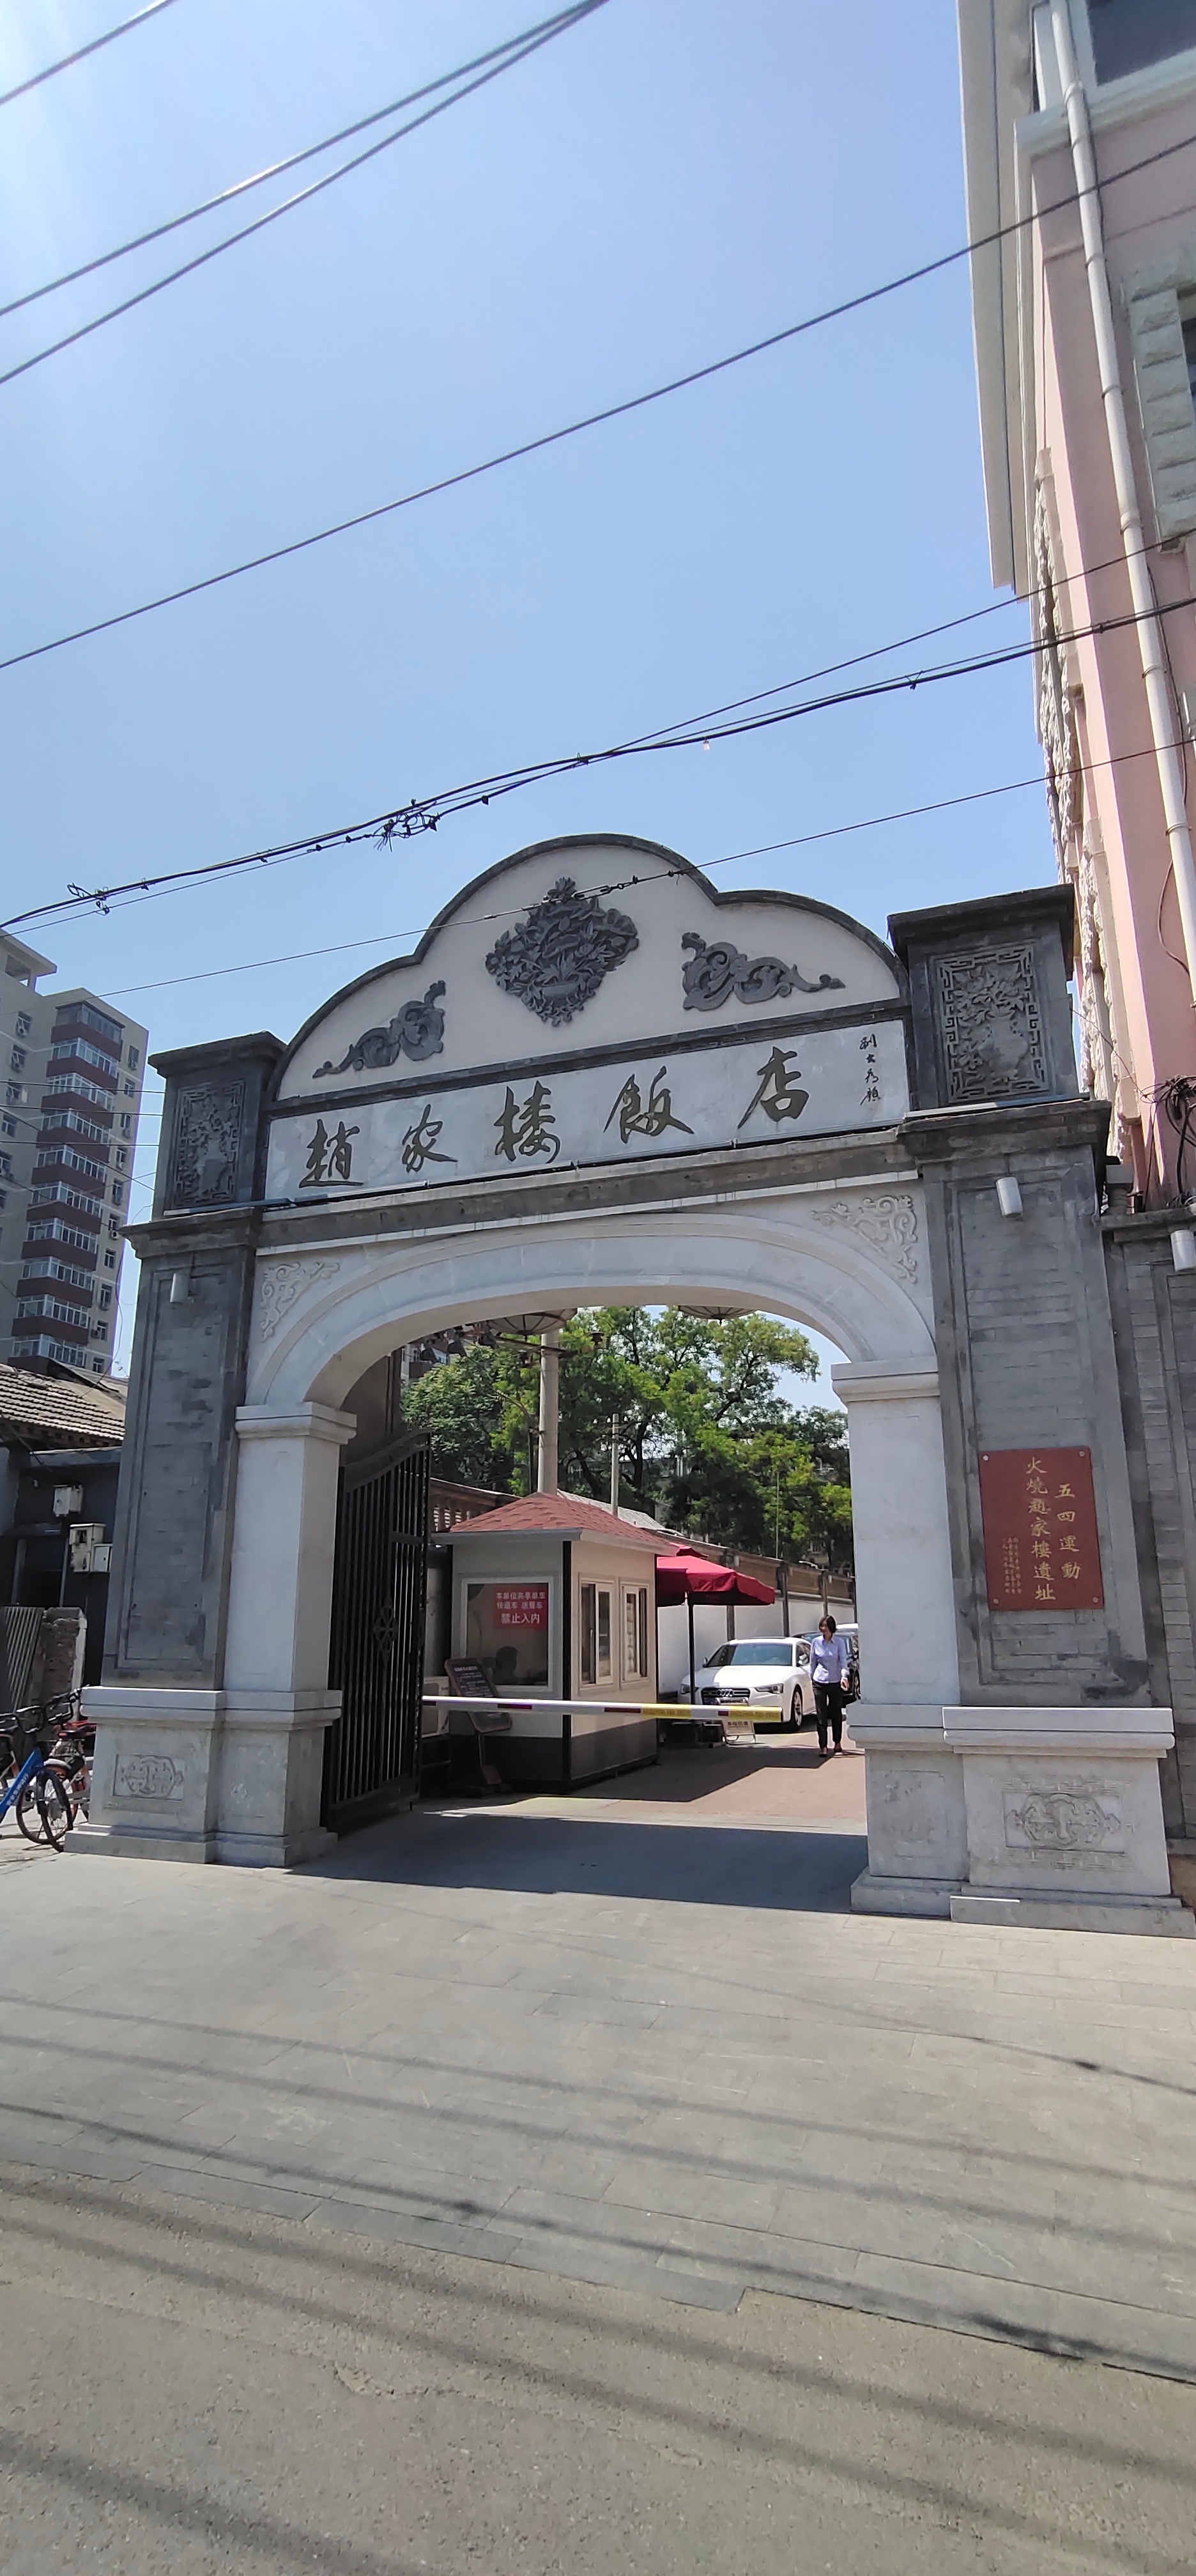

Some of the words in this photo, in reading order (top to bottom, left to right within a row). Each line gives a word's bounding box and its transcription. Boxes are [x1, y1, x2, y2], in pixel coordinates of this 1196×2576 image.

[1054, 1482, 1082, 1580] 五四運動
[500, 1612, 540, 1624] 禁止入内
